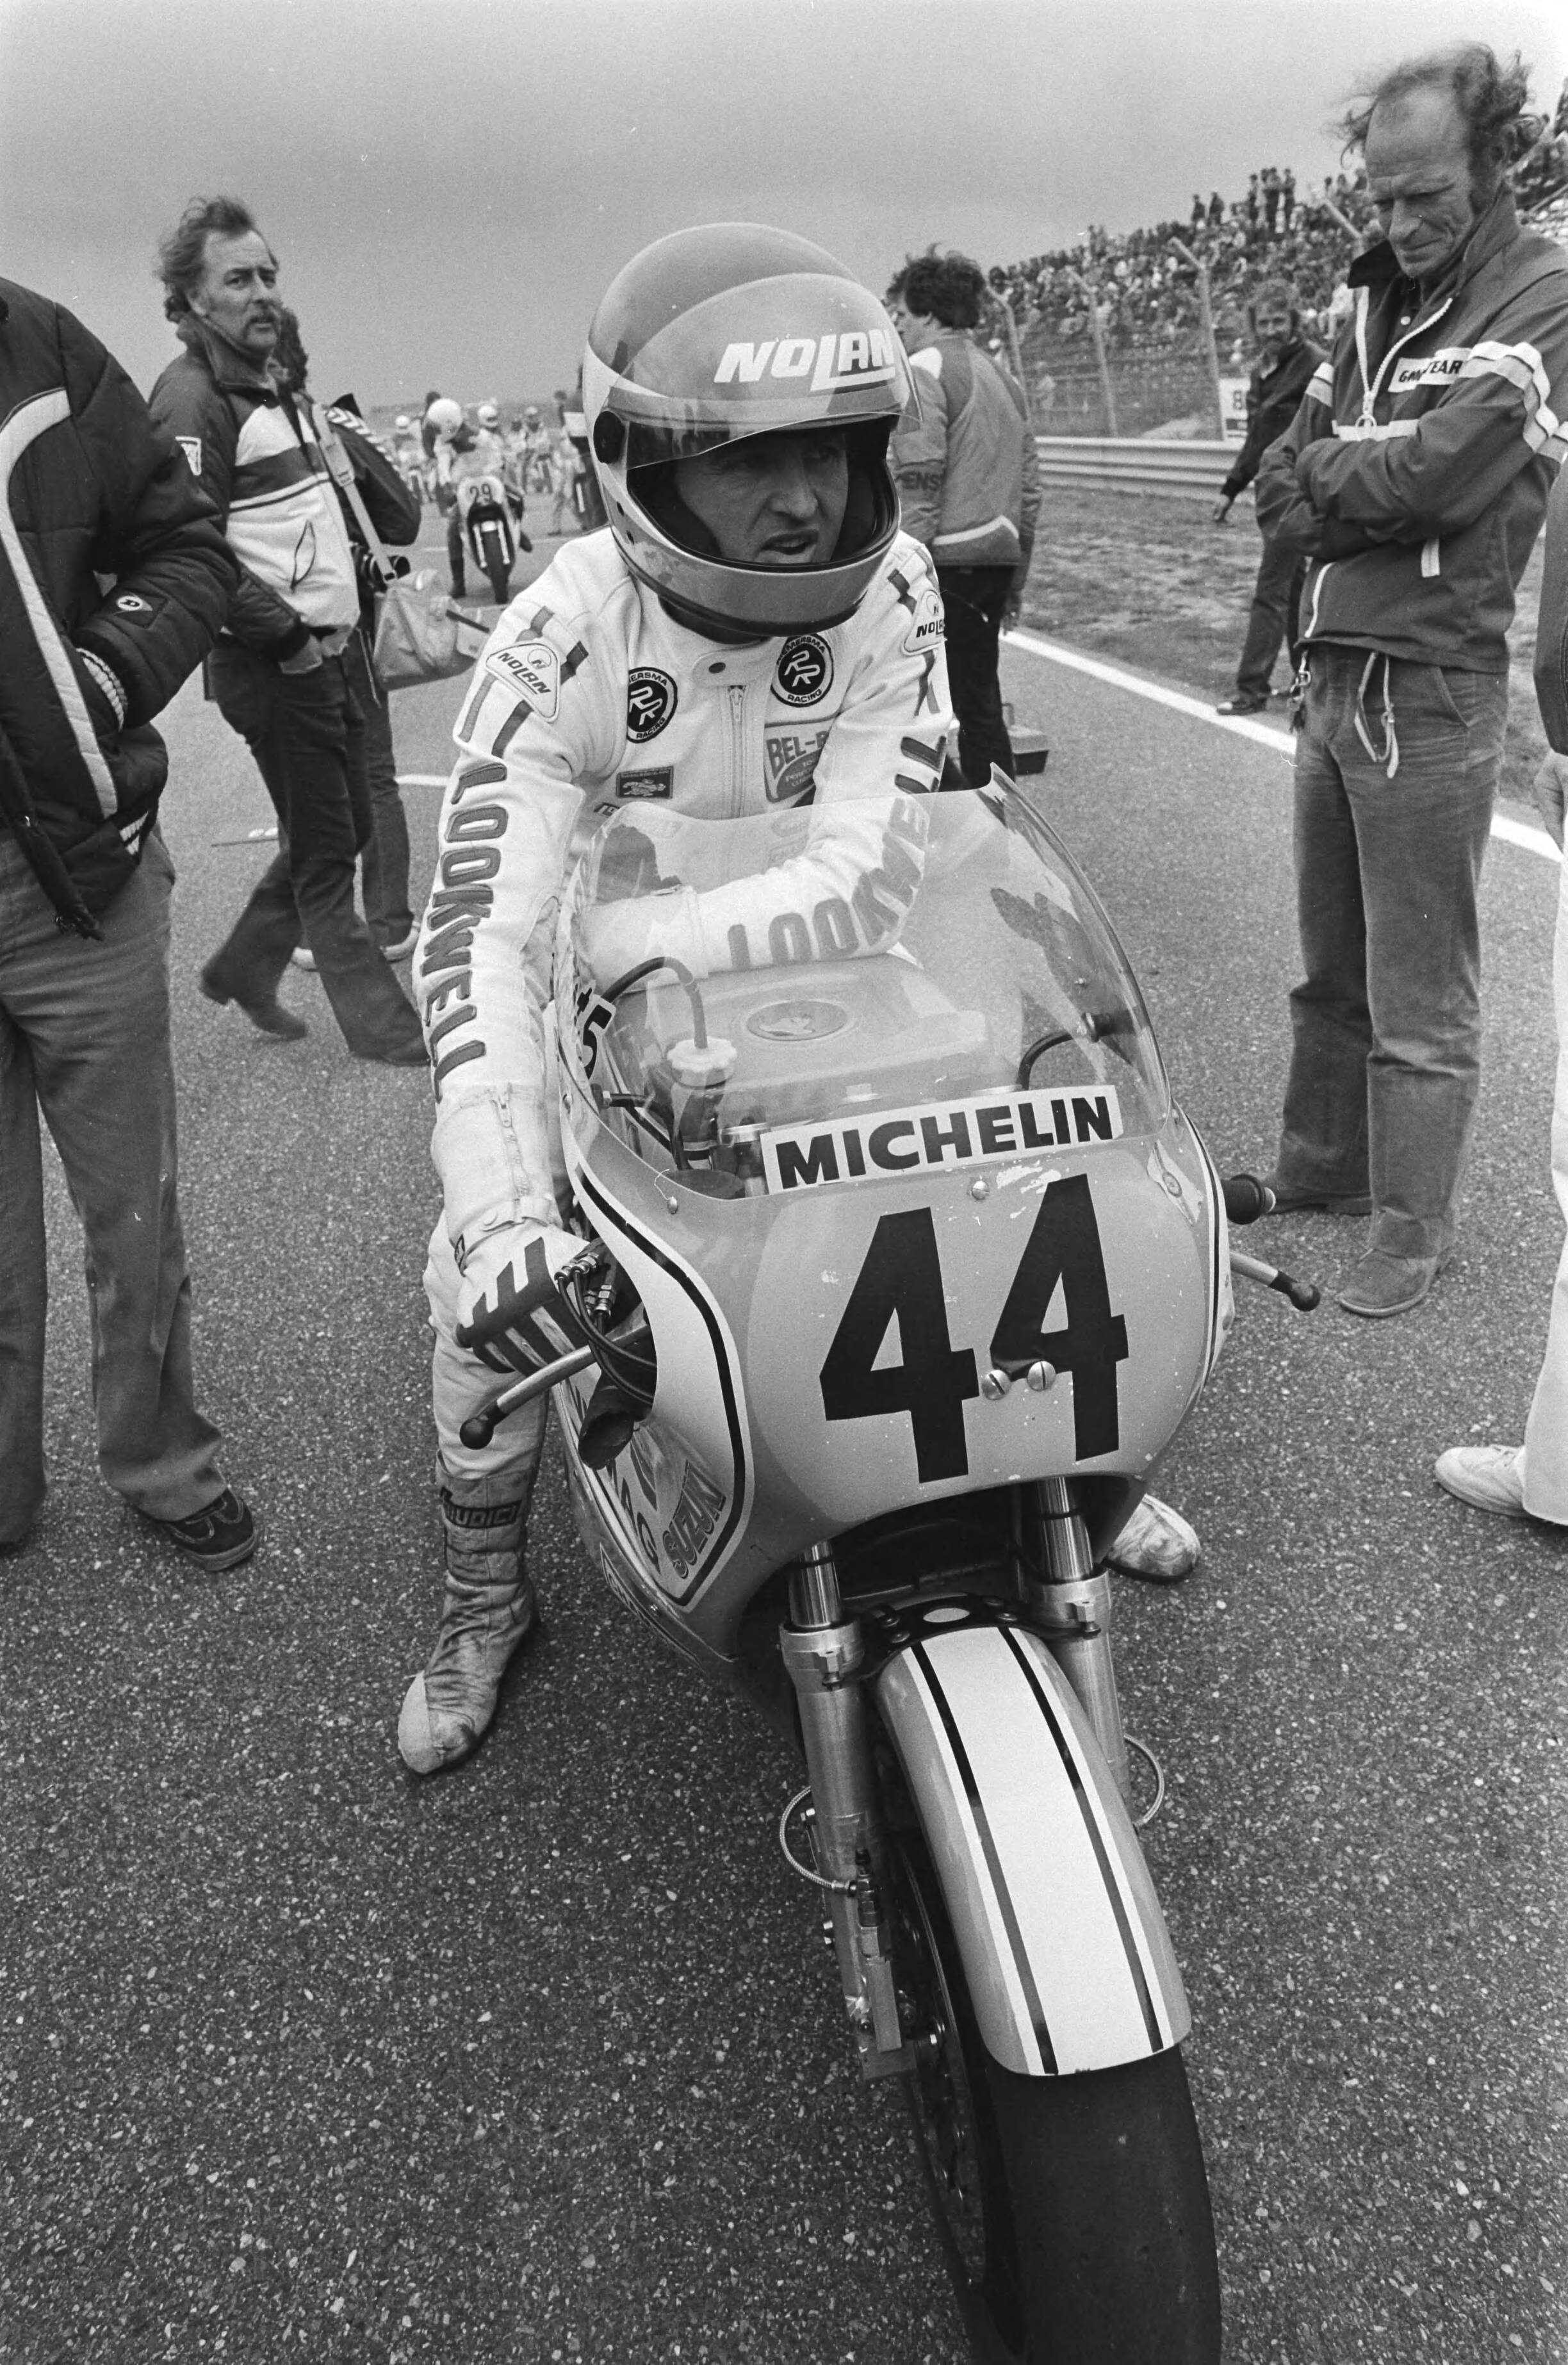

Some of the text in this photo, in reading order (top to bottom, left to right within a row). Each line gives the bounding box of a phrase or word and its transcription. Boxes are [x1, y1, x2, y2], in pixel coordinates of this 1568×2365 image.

[714, 329, 896, 391] NOLAN
[469, 482, 493, 506] 29
[916, 619, 945, 638] NOLA
[497, 652, 551, 695] NOLAN
[628, 671, 667, 686] ERSMA
[787, 688, 822, 703] RACING
[636, 716, 666, 739] RACING
[420, 762, 509, 1104] LOOKWELL
[776, 1095, 1113, 1190] MICHELIN
[819, 1173, 1129, 1484] 44
